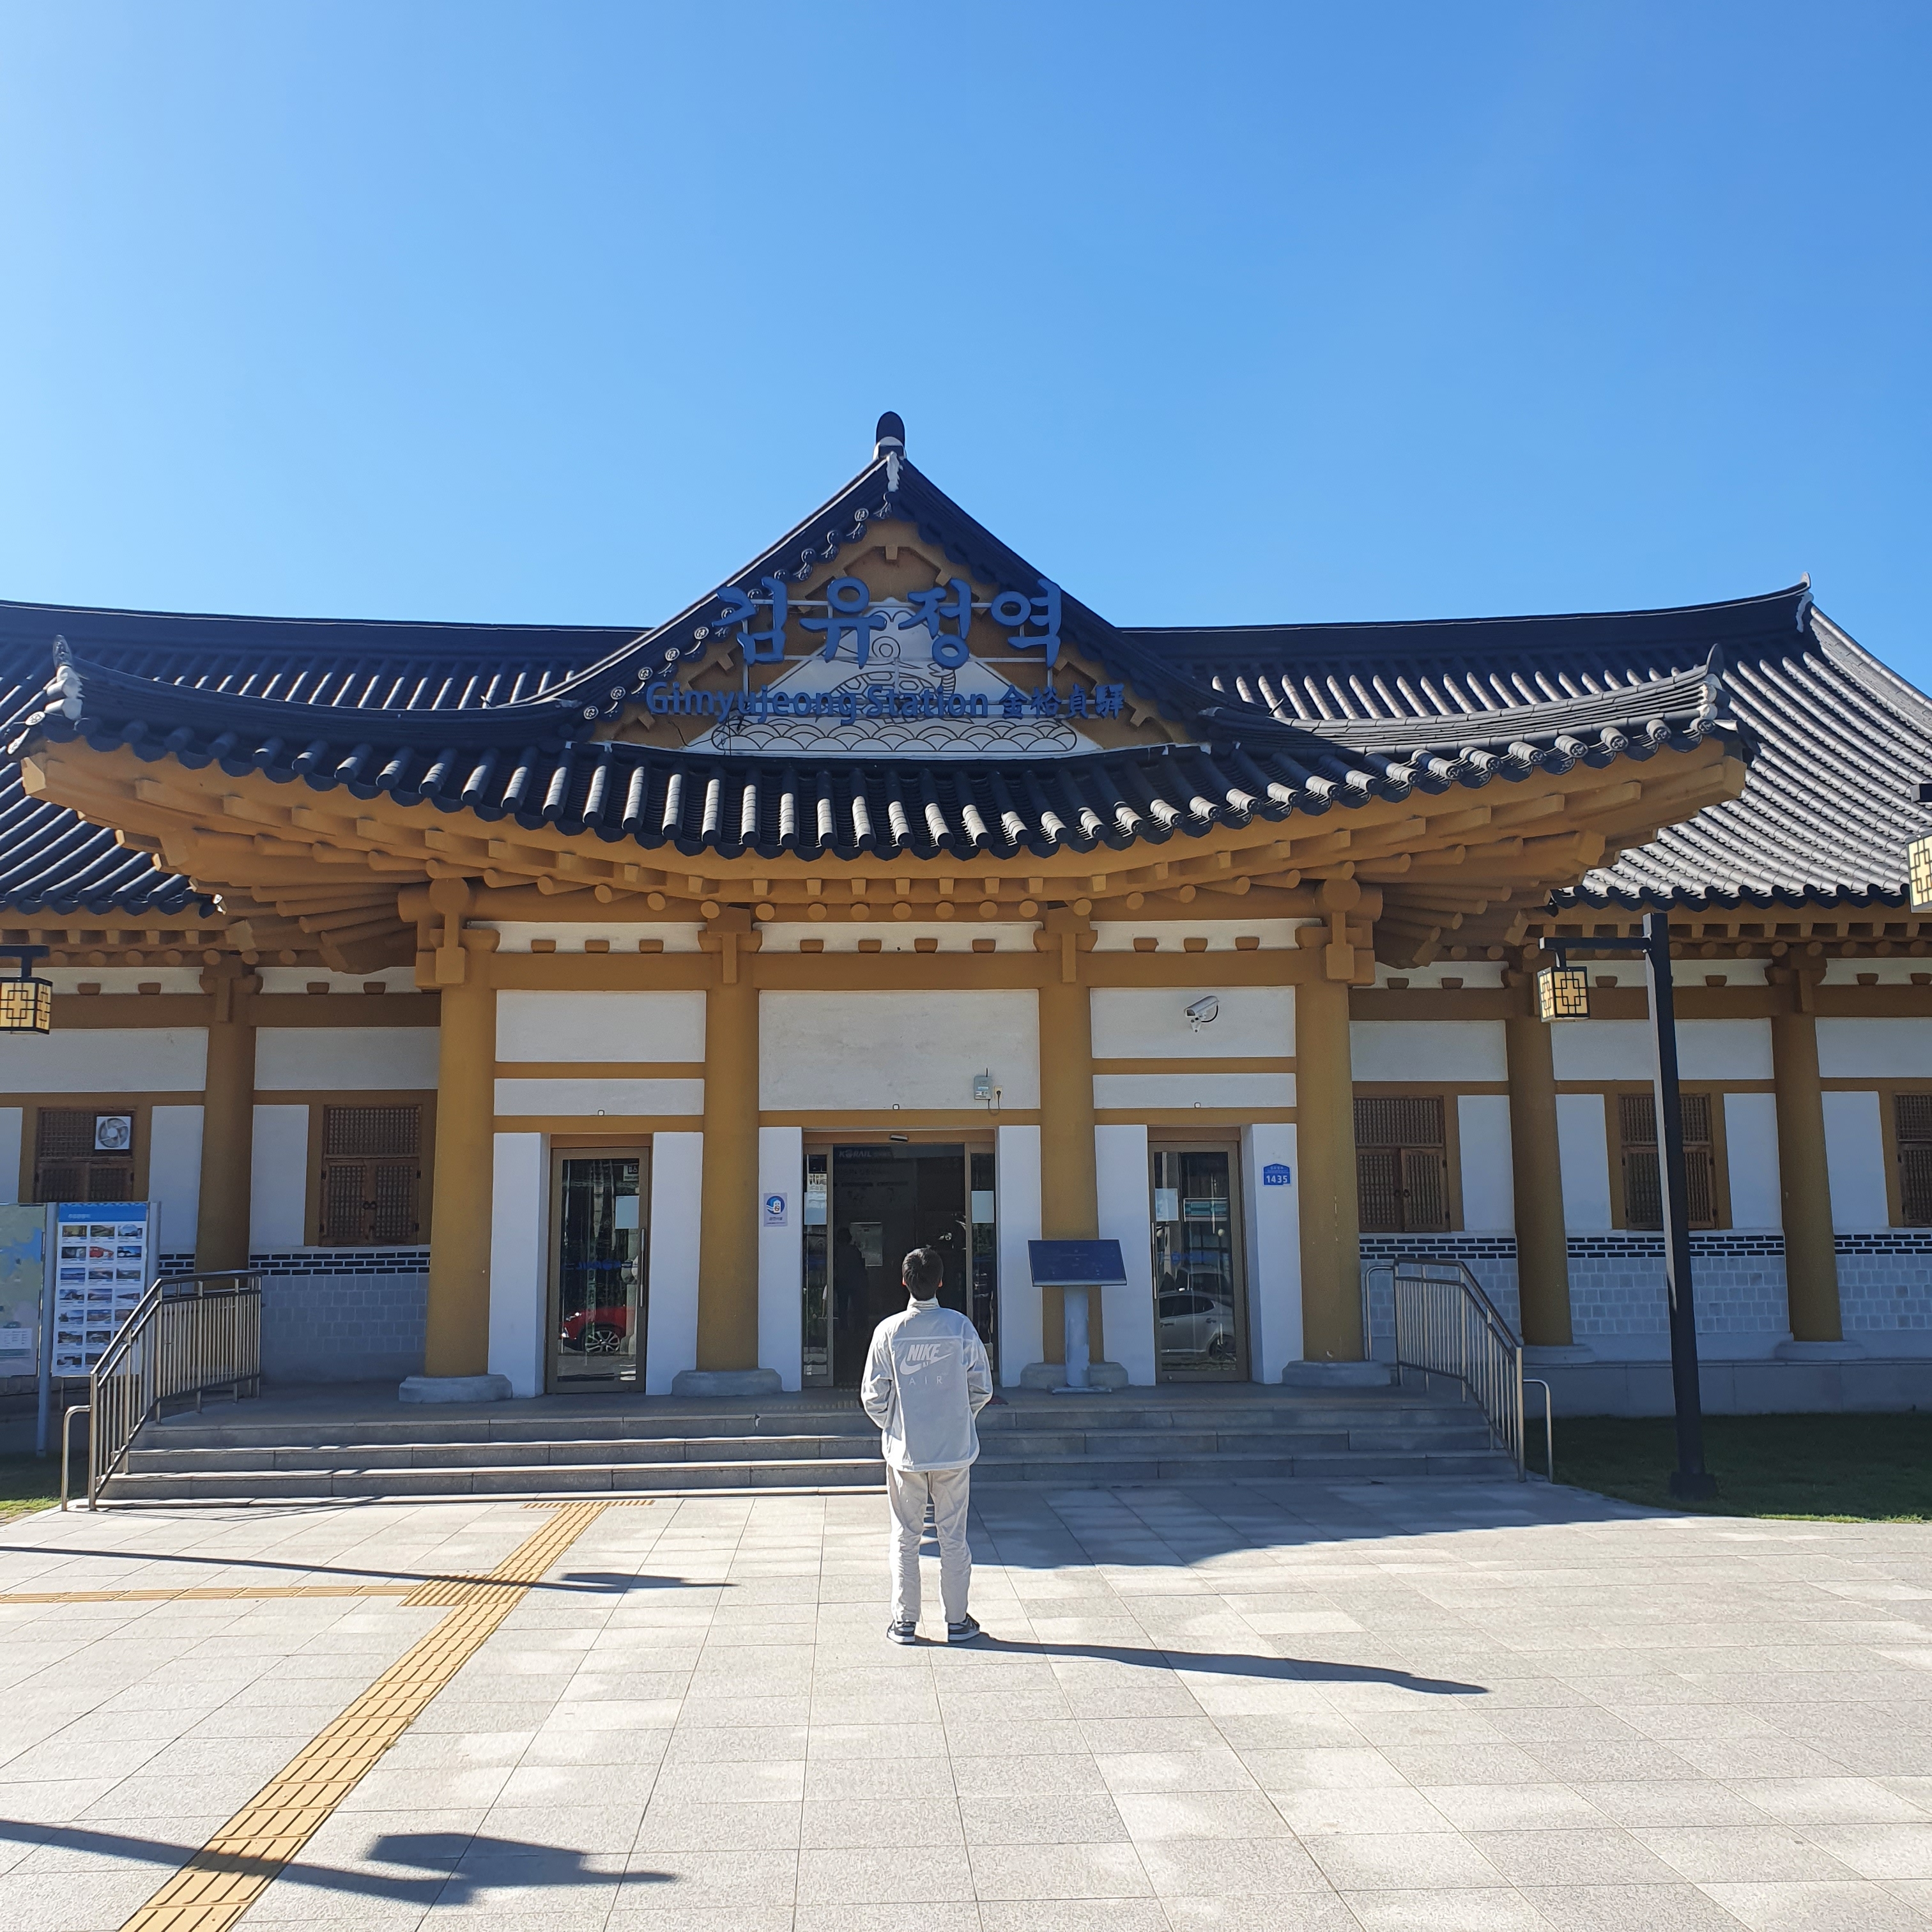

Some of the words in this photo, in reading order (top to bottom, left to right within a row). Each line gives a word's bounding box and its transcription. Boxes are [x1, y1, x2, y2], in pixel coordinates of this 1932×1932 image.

[711, 576, 1062, 670] 김유정역
[646, 681, 857, 726] Gimyujeong
[866, 684, 989, 718] Station
[999, 683, 1125, 720] 金裕貞驛
[1266, 1175, 1288, 1183] 1435
[907, 1343, 941, 1362] NIKE
[908, 1375, 944, 1385] AIR
